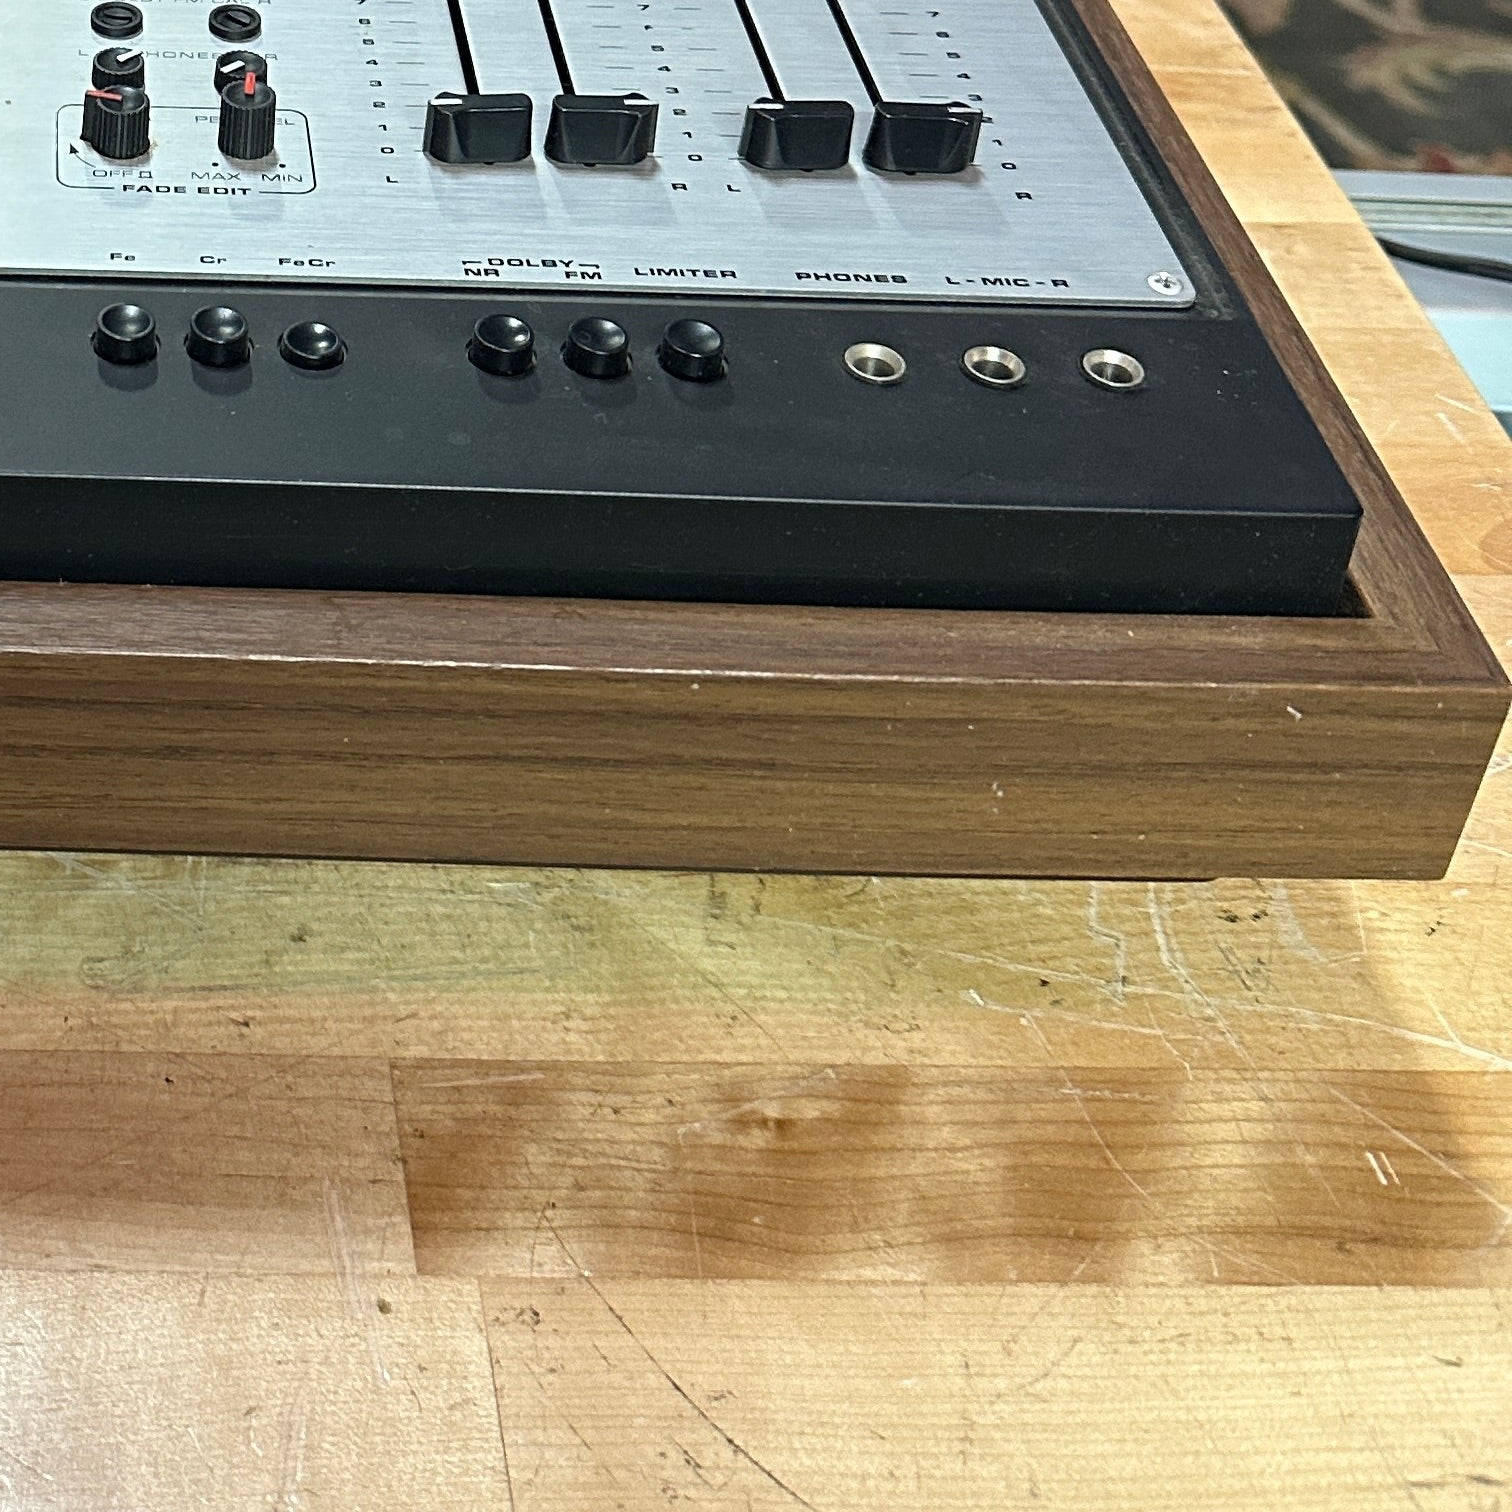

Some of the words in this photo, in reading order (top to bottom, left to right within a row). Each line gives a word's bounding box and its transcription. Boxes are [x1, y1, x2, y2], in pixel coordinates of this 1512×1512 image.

[92, 169, 134, 178] OFF
[191, 171, 242, 182] MAX
[261, 173, 303, 183] MIN
[122, 184, 187, 194] FADE
[197, 186, 252, 196] EDIT
[726, 184, 742, 193] L
[109, 252, 136, 261] Fe
[199, 255, 227, 264] Cr
[278, 257, 336, 267] FeCr
[487, 258, 574, 268] DOLBY
[463, 268, 501, 278] NR
[565, 271, 603, 280] FM
[634, 267, 738, 279] LIMITER
[794, 271, 908, 284] PHONES
